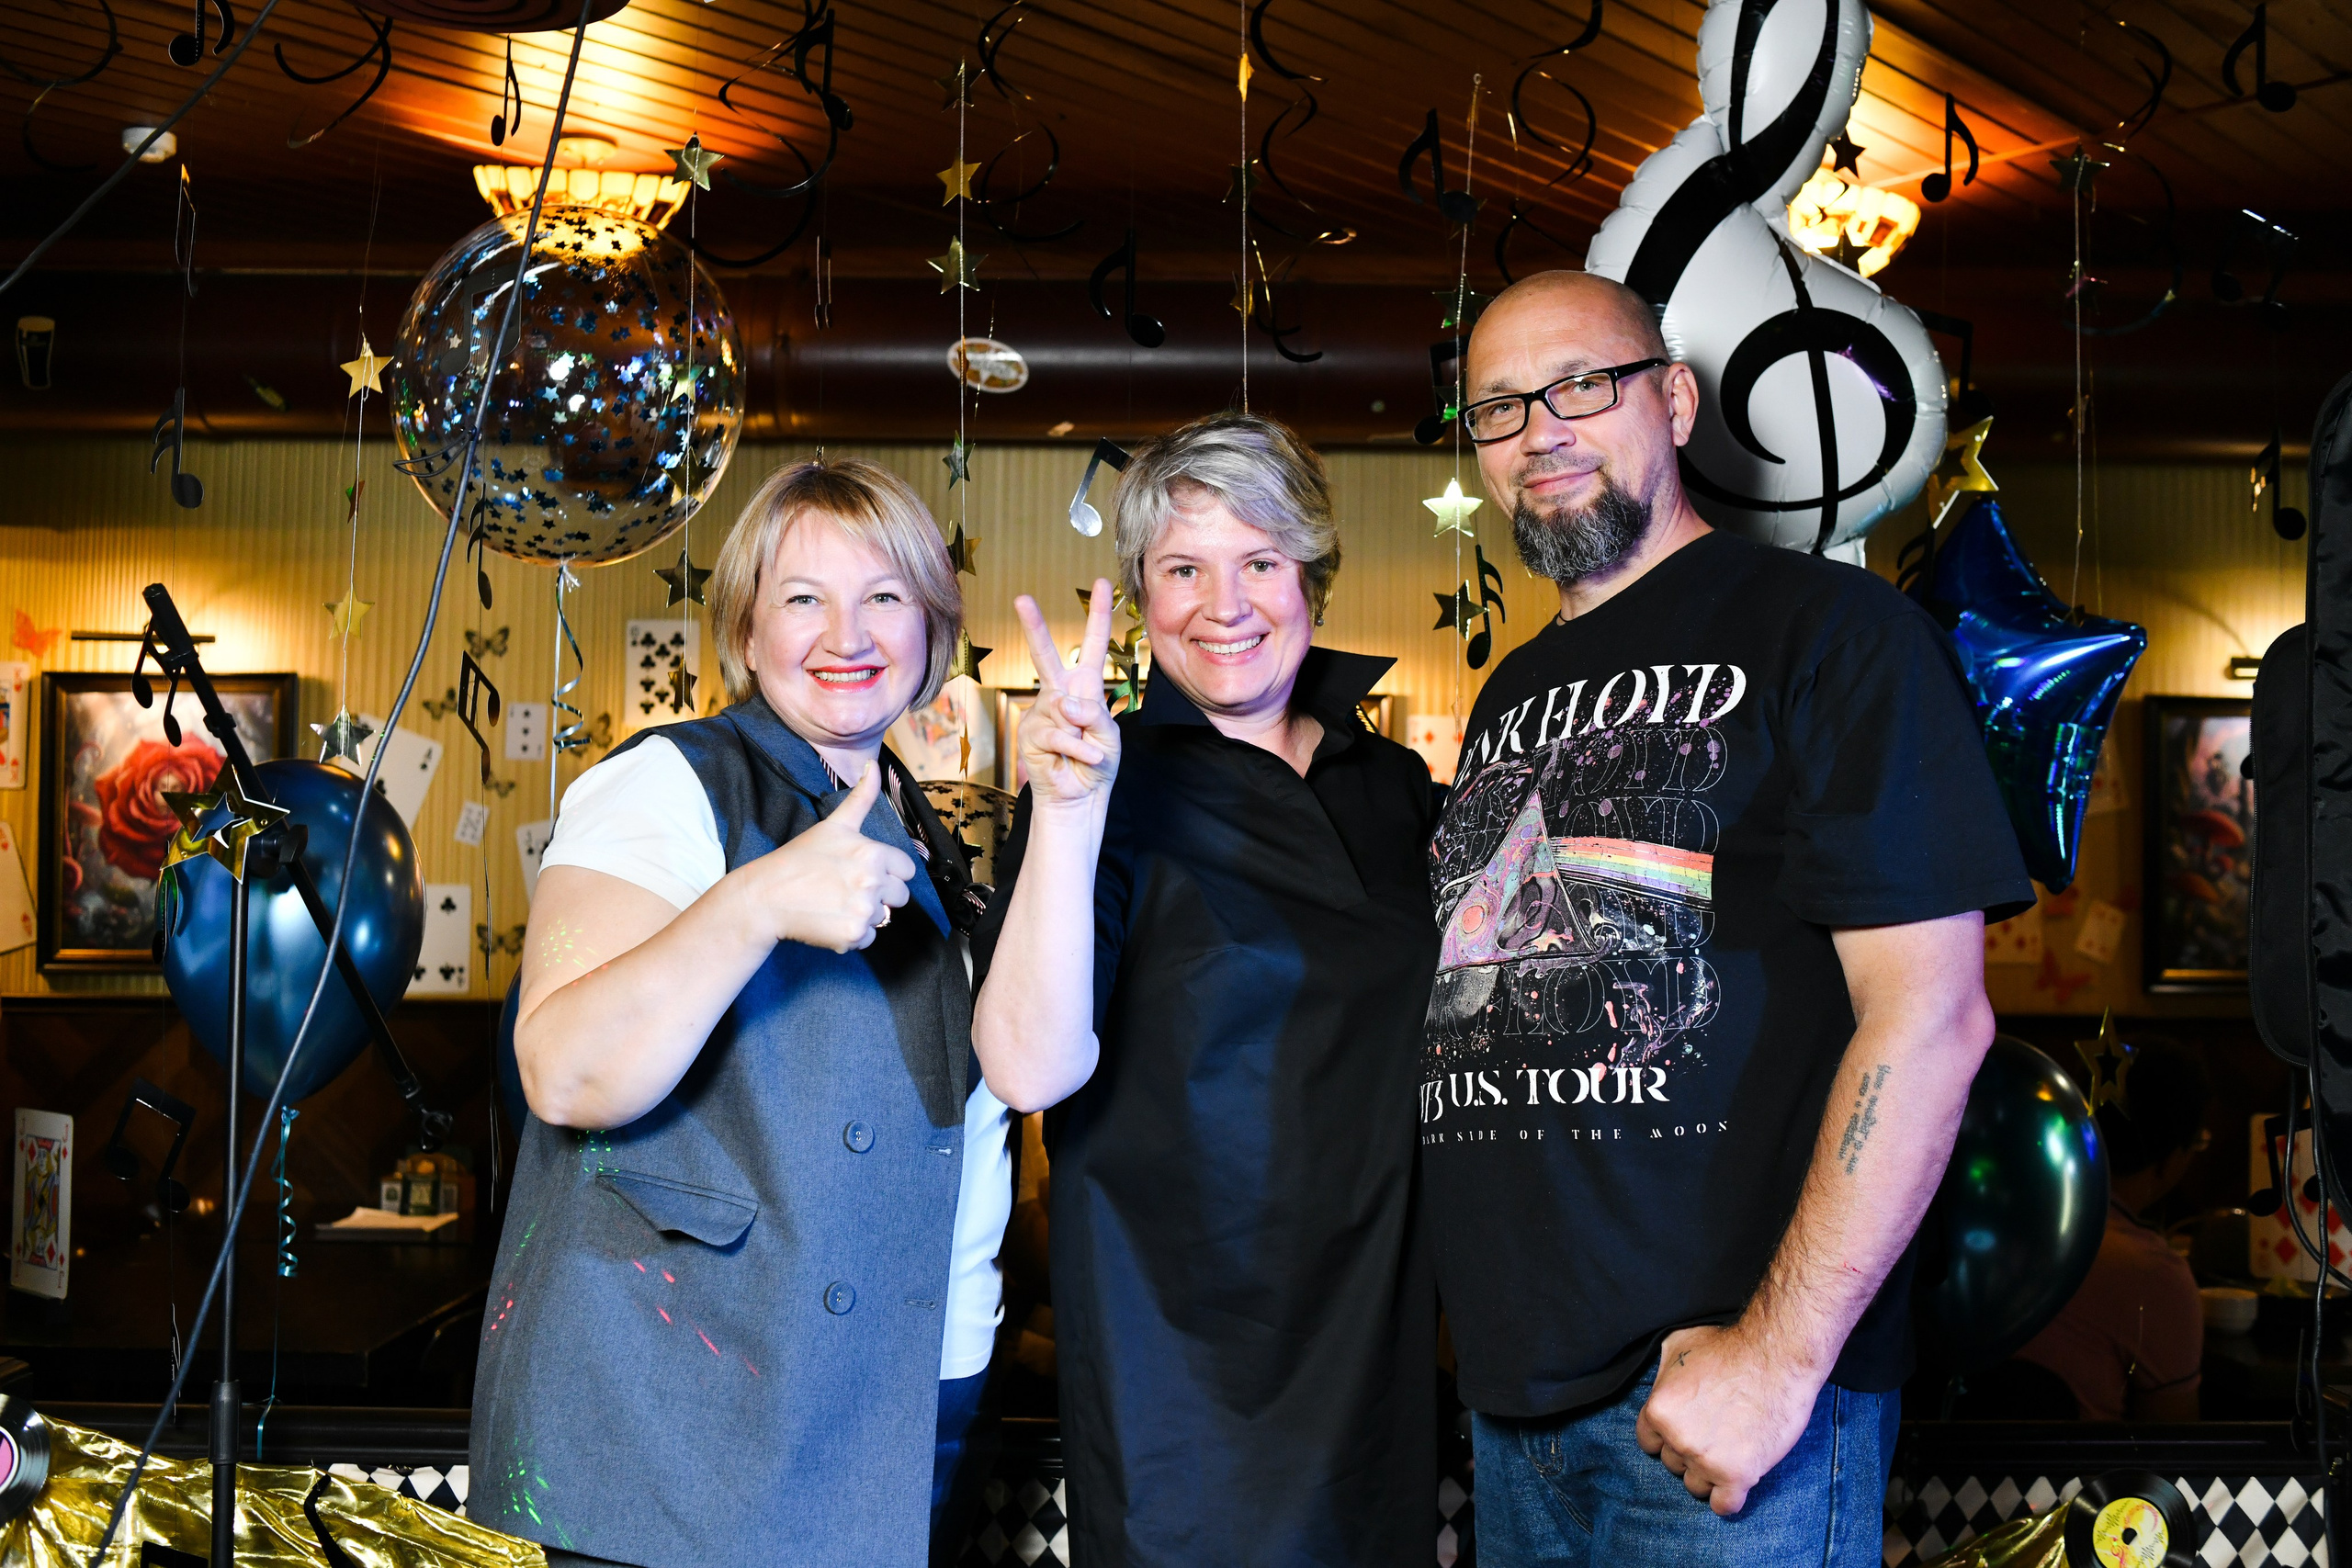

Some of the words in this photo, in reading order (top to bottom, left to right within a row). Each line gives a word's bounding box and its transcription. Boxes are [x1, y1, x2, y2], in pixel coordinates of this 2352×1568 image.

[1535, 663, 1747, 749] FLOYD
[1449, 1070, 1509, 1108] U.S.
[1516, 1066, 1670, 1105] TOUR
[1456, 1129, 1497, 1142] SIDE
[1519, 1129, 1545, 1141] OF
[1571, 1128, 1623, 1141] THE
[1649, 1120, 1728, 1139] MOON
